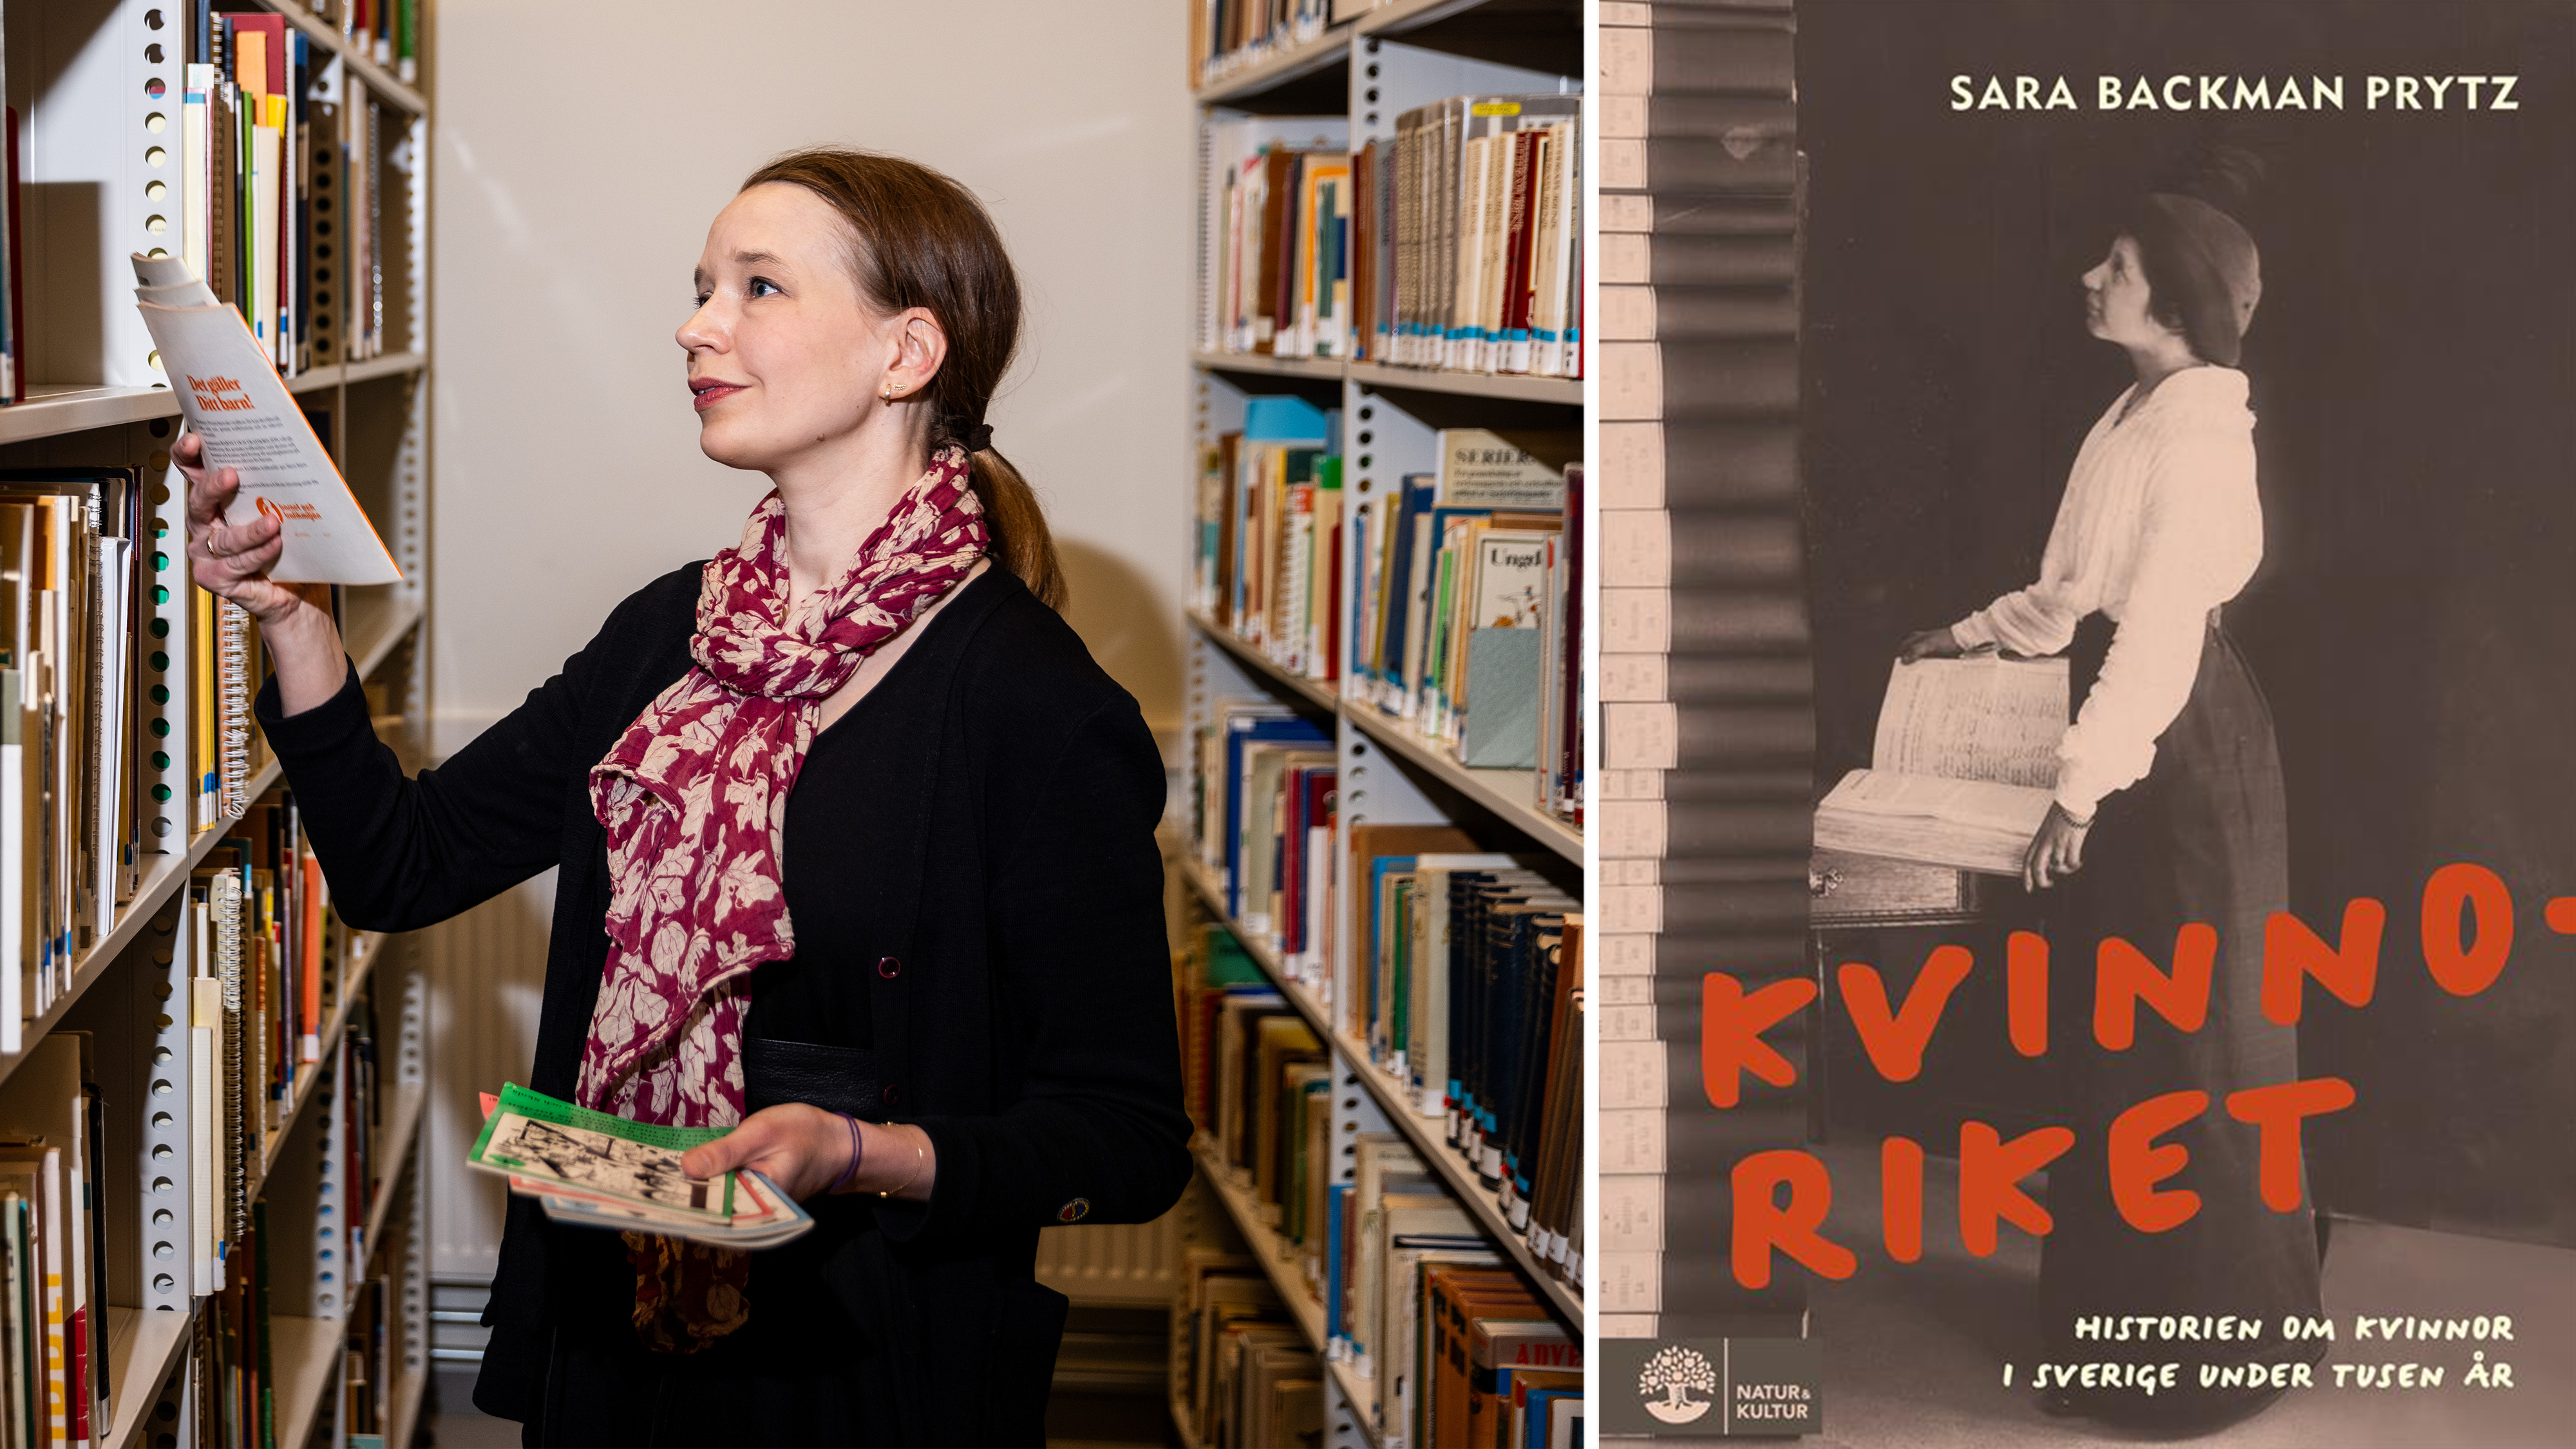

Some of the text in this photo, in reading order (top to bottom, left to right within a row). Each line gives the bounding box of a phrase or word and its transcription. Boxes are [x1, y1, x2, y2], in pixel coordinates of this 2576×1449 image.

[1951, 75, 2519, 111] SARA BACKMAN PRYTZ
[187, 374, 242, 396] Det gäller
[194, 392, 256, 412] Ditt barn!
[1732, 1078, 2356, 1290] RIKET
[2075, 1315, 2515, 1341] HISTORIEN OM KVINNOR
[2003, 1350, 2515, 1396] I SVERIGE UNDER TUSEN ÅR
[1736, 1384, 1811, 1400] NATUR&
[1736, 1403, 1808, 1419] KULTUR
